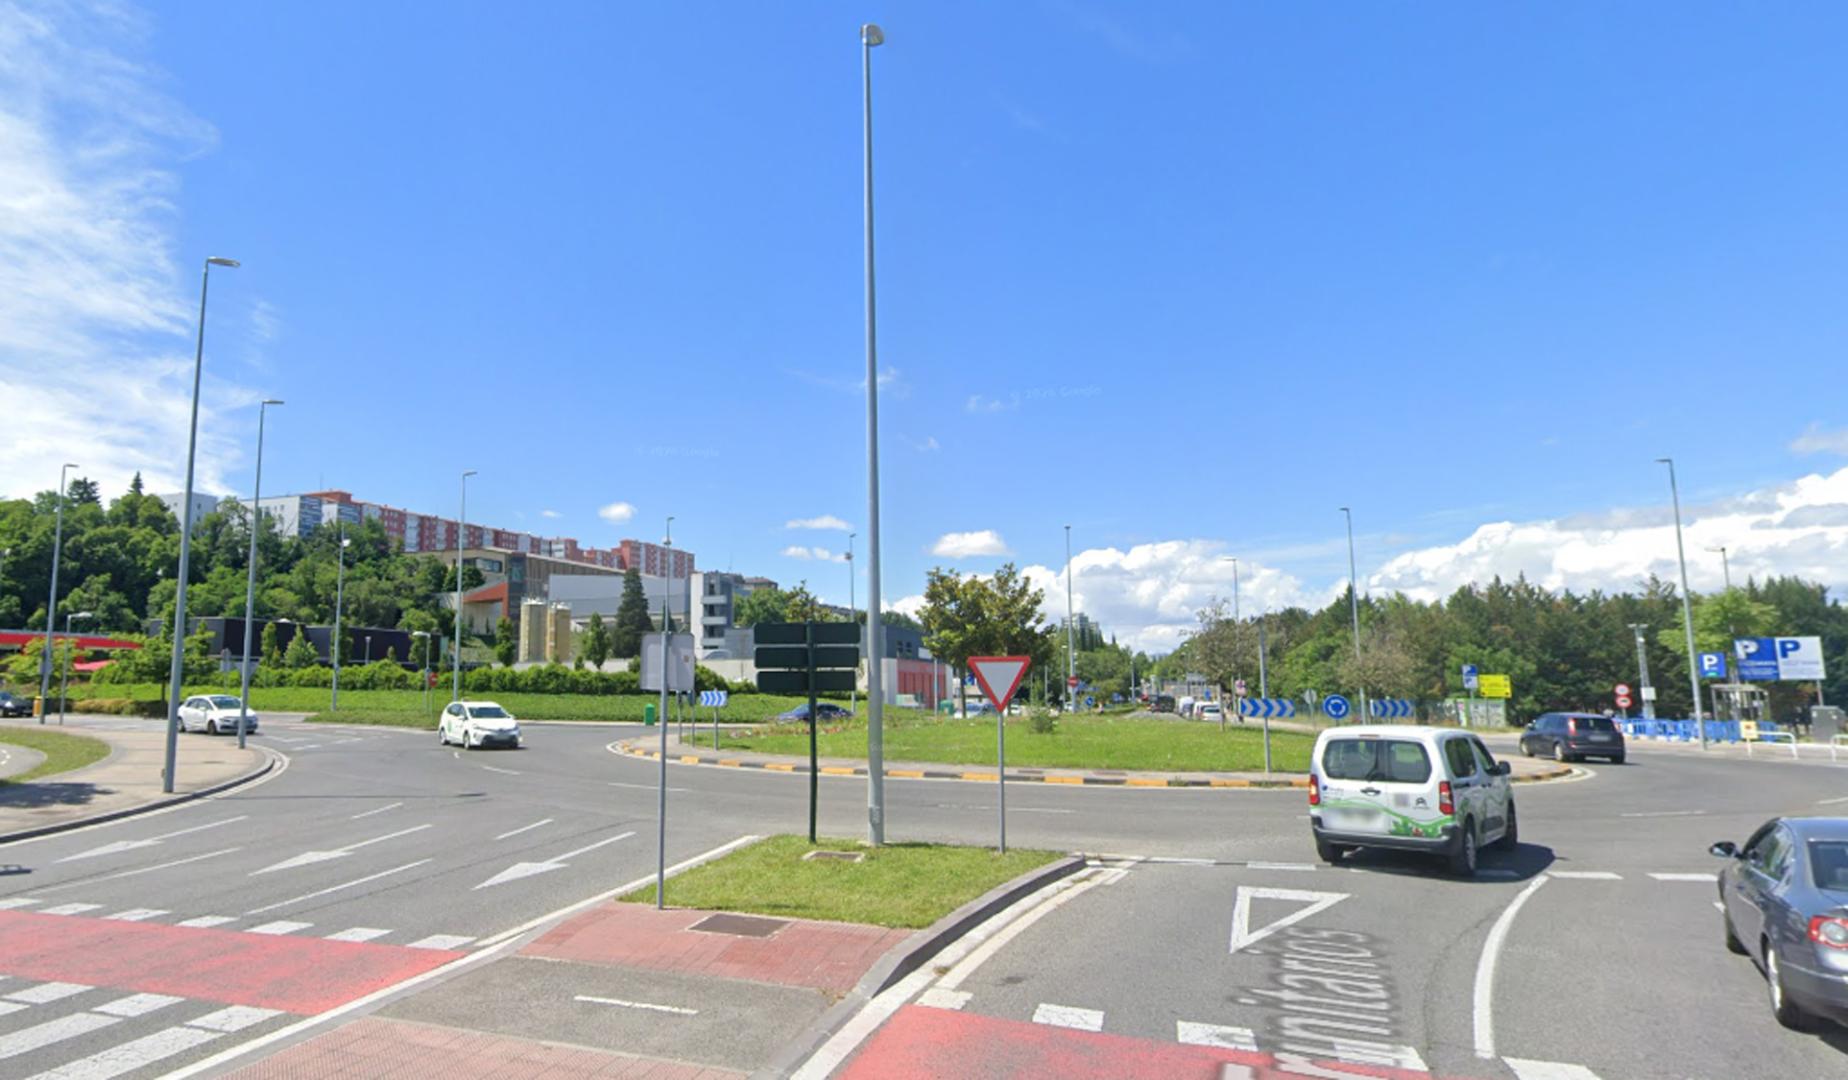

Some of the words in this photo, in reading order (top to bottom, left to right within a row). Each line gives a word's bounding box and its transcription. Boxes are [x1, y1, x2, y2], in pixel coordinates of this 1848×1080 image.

[1735, 640, 1759, 659] P
[1780, 640, 1801, 658] P
[1703, 654, 1718, 670] P
